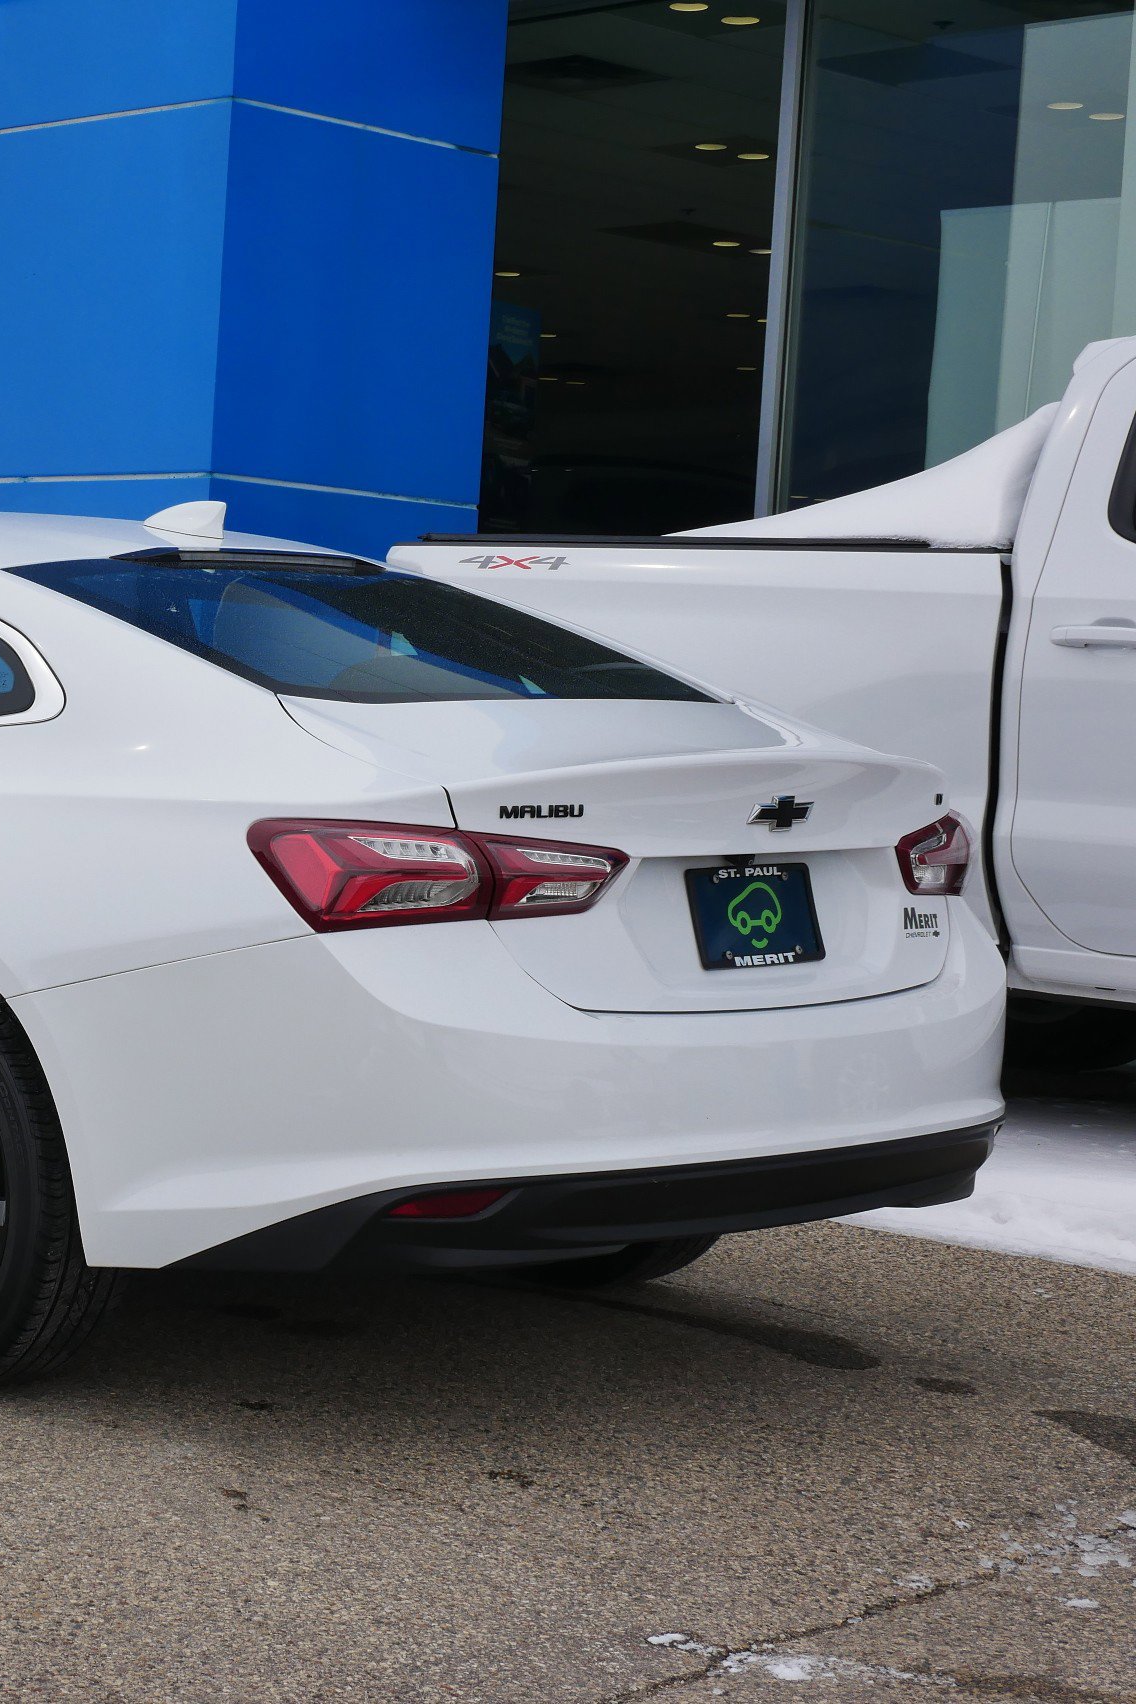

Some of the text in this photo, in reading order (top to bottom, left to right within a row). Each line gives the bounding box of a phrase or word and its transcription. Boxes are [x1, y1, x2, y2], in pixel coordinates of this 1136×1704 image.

[499, 804, 584, 819] MALIBU
[718, 866, 782, 878] ST. PAUL
[734, 952, 796, 967] MERIT
